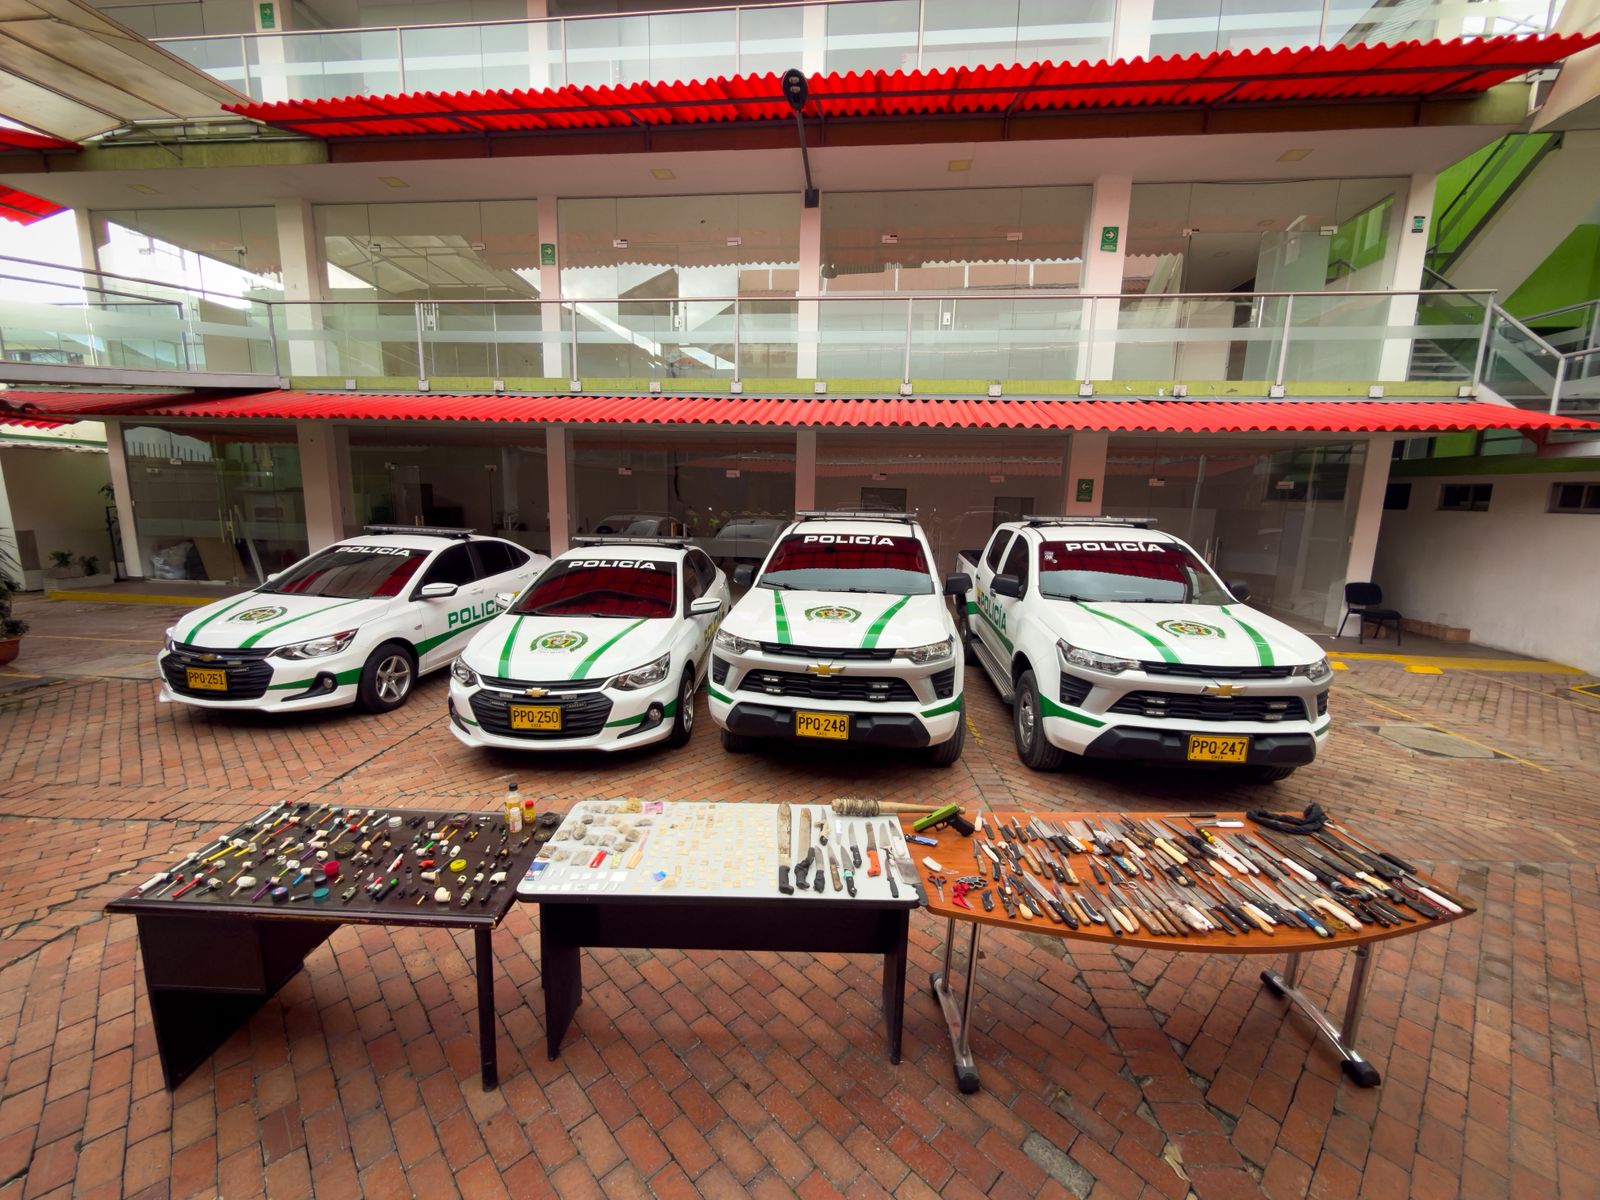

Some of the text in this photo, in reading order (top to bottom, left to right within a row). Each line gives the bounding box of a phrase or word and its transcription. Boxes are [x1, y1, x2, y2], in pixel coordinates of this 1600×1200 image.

[804, 535, 894, 546] POLICÍA
[1065, 541, 1166, 553] POLICÍA
[568, 560, 656, 570] POLICÍA
